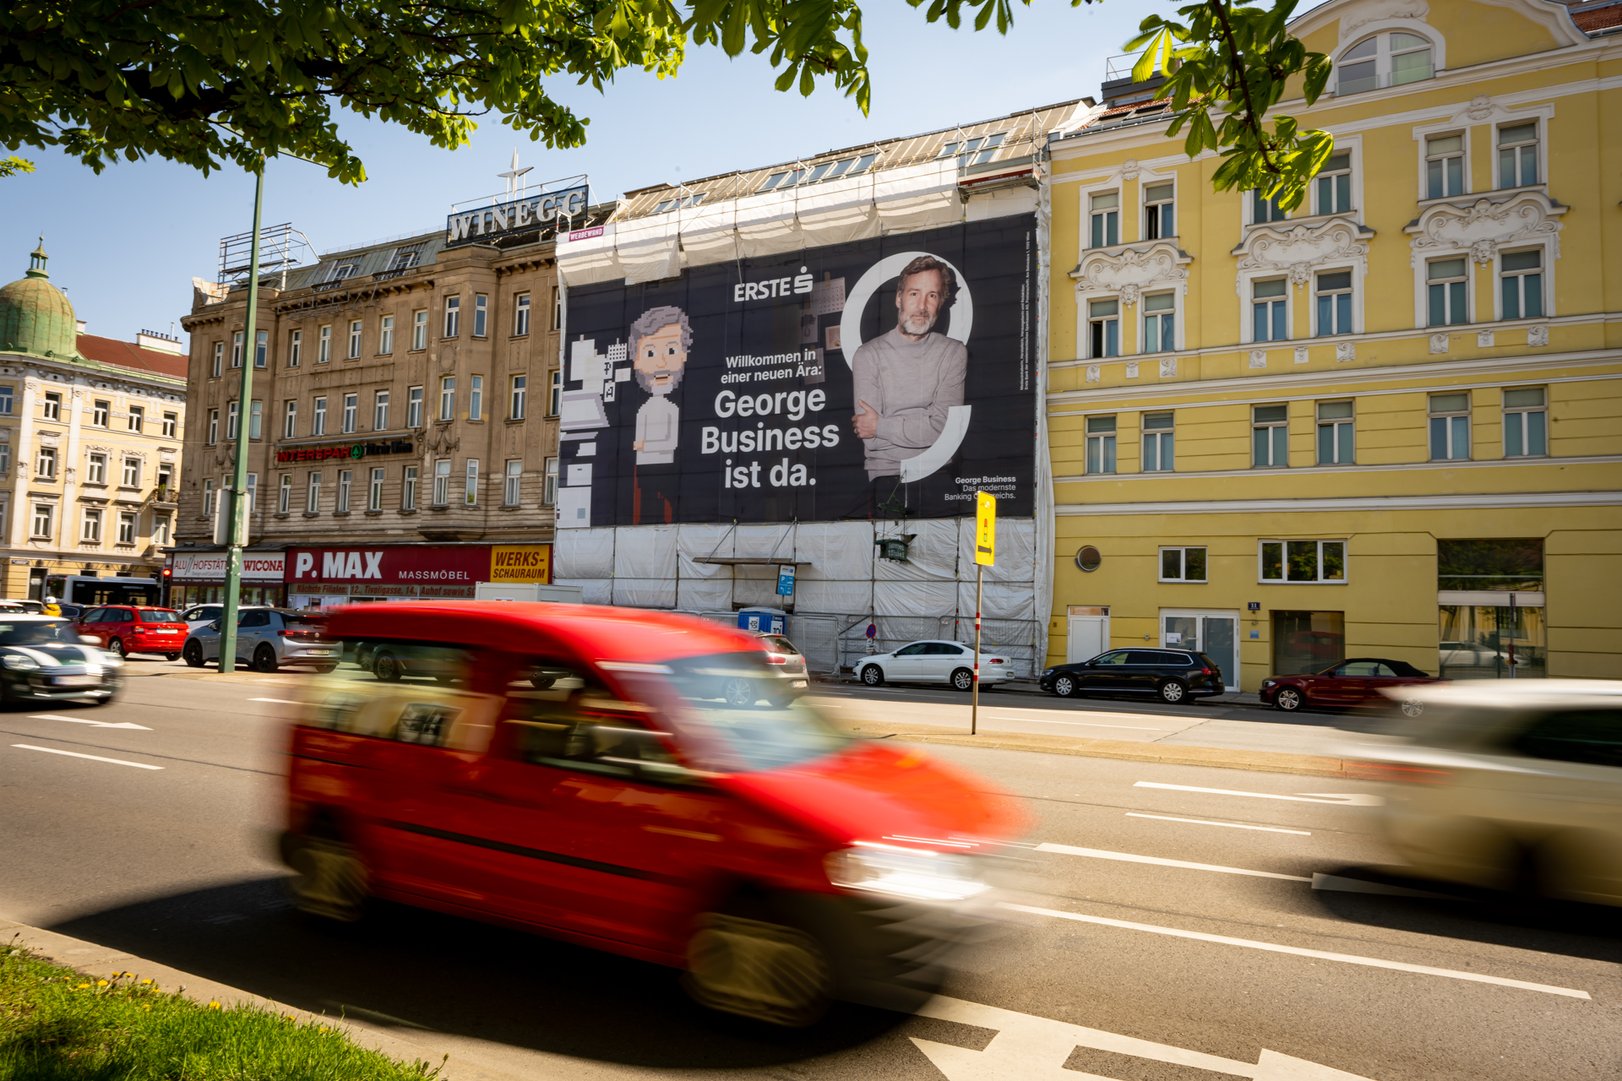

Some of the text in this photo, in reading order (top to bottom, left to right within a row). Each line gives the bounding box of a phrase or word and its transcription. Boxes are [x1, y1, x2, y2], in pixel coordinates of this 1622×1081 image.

[450, 190, 585, 241] WINEGG
[734, 277, 791, 302] ERSTE
[725, 348, 816, 369] Willkommen in
[720, 361, 822, 384] einer neuen Ära:
[714, 388, 826, 421] George
[701, 421, 840, 455] Business
[277, 446, 351, 463] INTERSPAR
[725, 457, 816, 488] ist da.
[982, 475, 1016, 483] Business
[944, 493, 972, 501] Banking
[962, 483, 1016, 492] Das modernste
[243, 560, 284, 571] WICONA
[322, 551, 384, 579] MAX
[495, 551, 545, 567] WERKS-
[398, 569, 470, 581] MASSMÖBEL
[492, 568, 546, 579] SCHAURAUM
